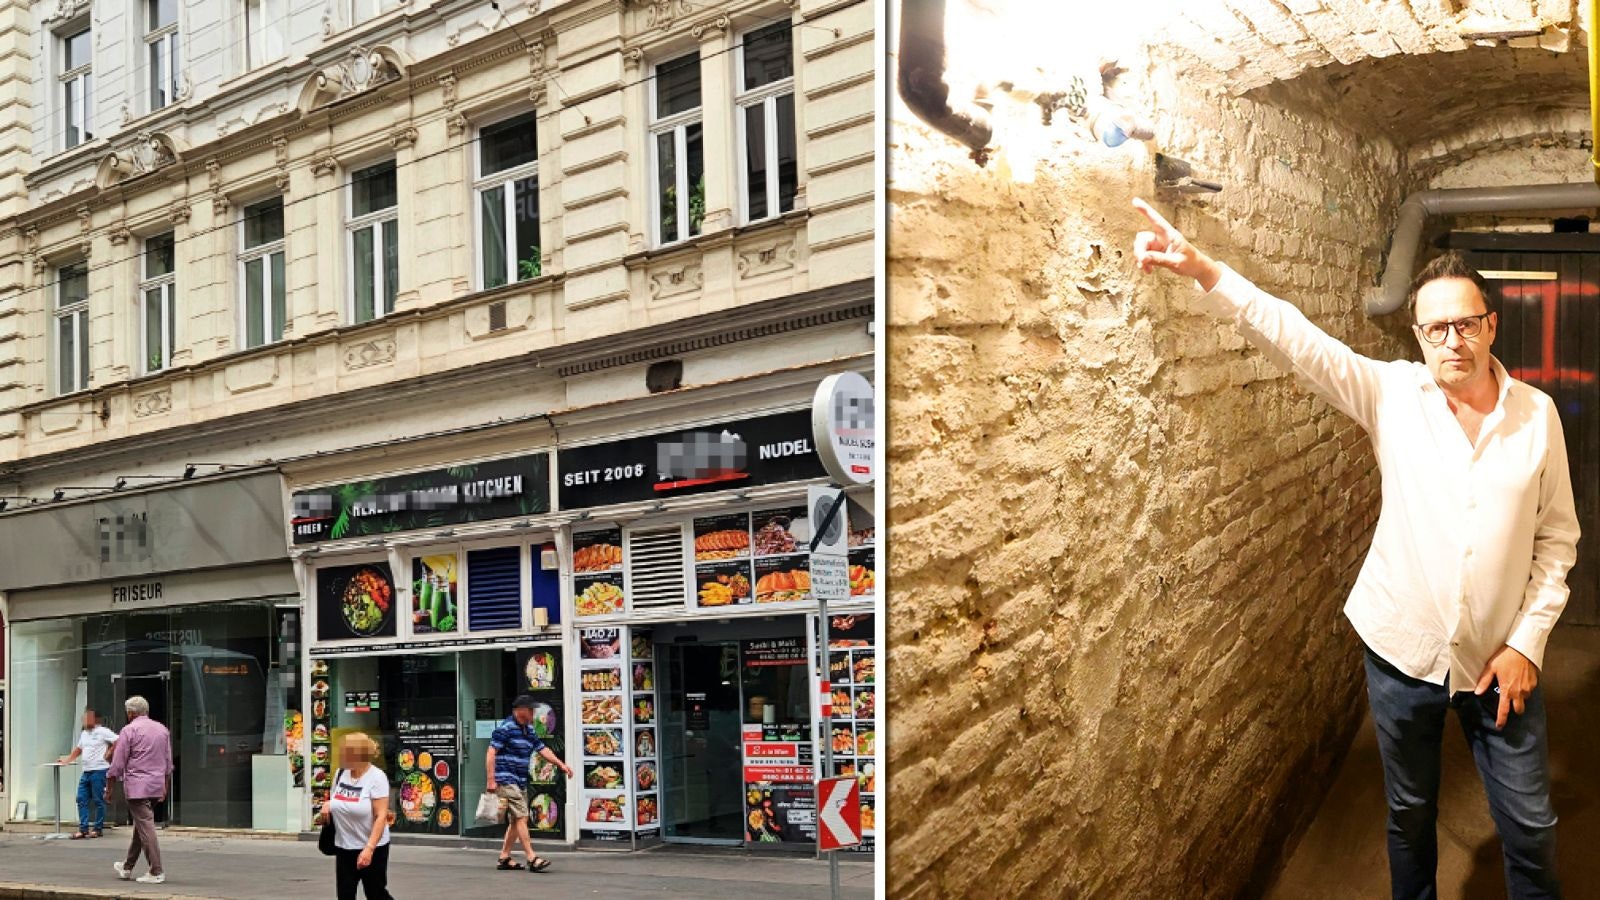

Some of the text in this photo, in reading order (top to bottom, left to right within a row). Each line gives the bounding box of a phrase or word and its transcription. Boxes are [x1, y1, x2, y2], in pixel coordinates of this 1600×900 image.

[759, 438, 812, 460] NUDEL
[564, 464, 644, 487] SEIT 2008
[462, 474, 523, 500] KITCHEN
[298, 522, 321, 535] GREEN
[113, 582, 163, 602] FRISEUR
